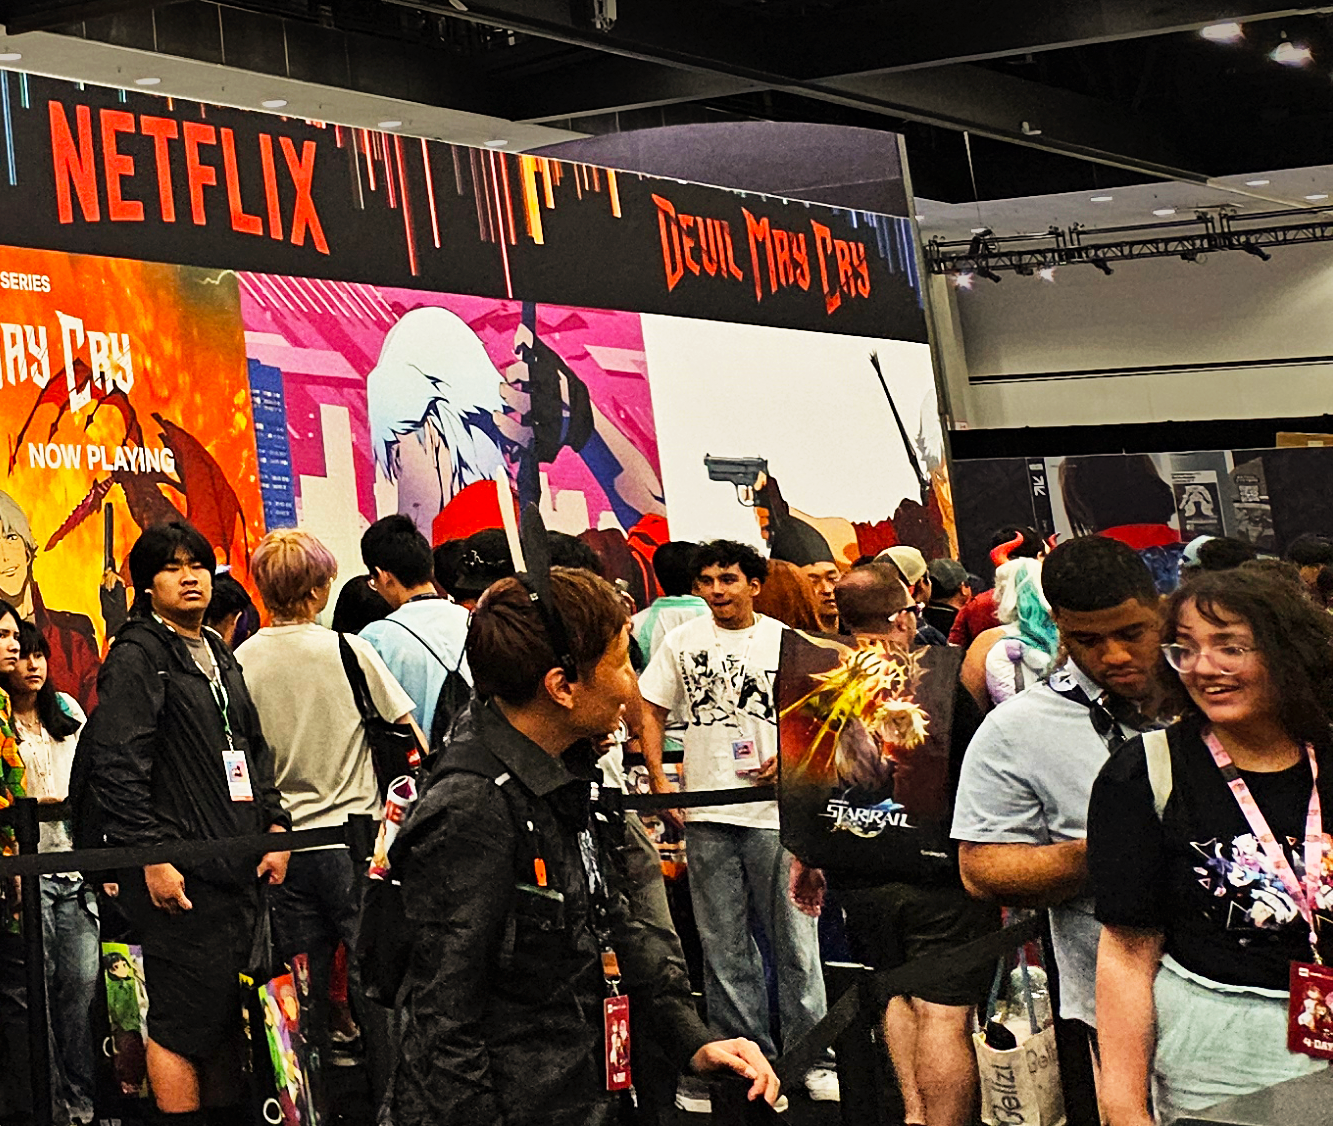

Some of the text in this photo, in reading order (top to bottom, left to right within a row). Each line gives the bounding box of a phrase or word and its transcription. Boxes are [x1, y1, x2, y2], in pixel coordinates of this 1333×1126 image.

[48, 100, 330, 255] NETFLIX
[0, 272, 51, 293] SERIES
[28, 442, 82, 469] NOW
[86, 444, 175, 474] PLAYING
